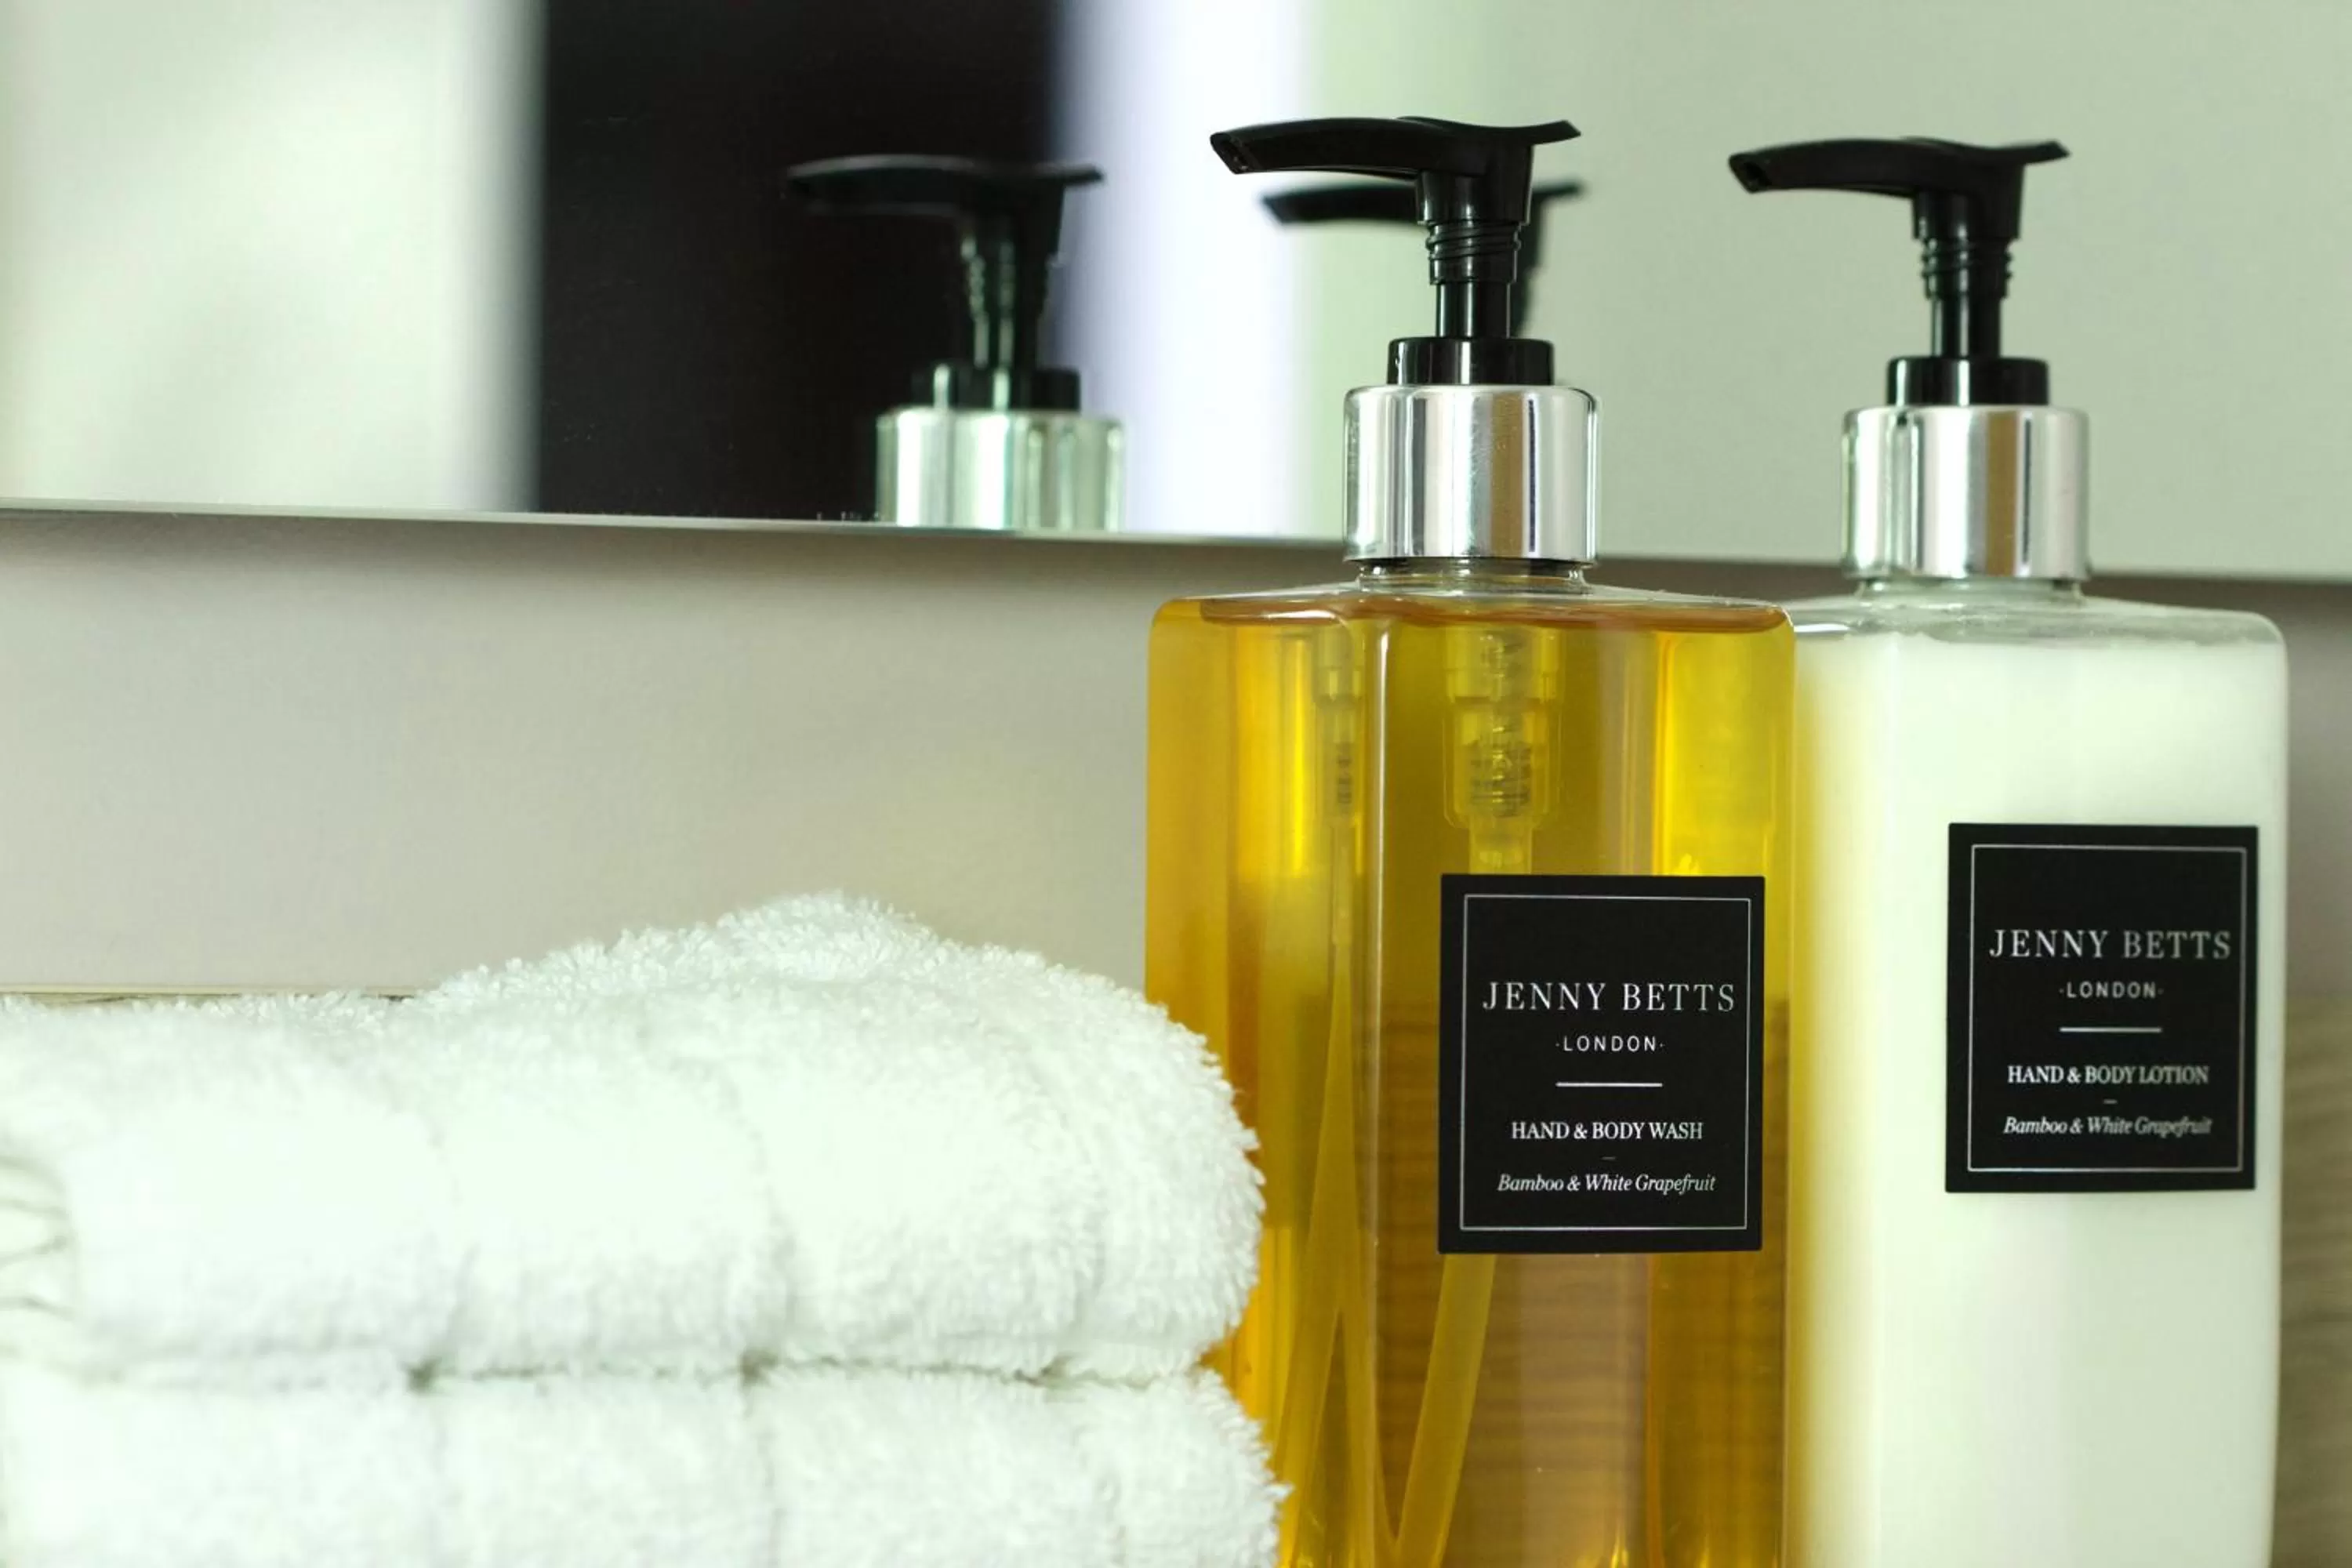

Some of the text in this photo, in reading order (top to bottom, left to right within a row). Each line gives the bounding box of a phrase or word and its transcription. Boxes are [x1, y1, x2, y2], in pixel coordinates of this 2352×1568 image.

[1989, 929, 2231, 960] JENNY BETTS
[1483, 982, 1735, 1011] JENNY BETTS
[2007, 1065, 2209, 1083] HAND & BODY LOTION
[1512, 1122, 1703, 1140] HAND & BODY WASH
[2003, 1116, 2212, 1138] Bamboo & White Grapefruit
[1497, 1174, 1715, 1195] Bamboo & White Grapefruit
